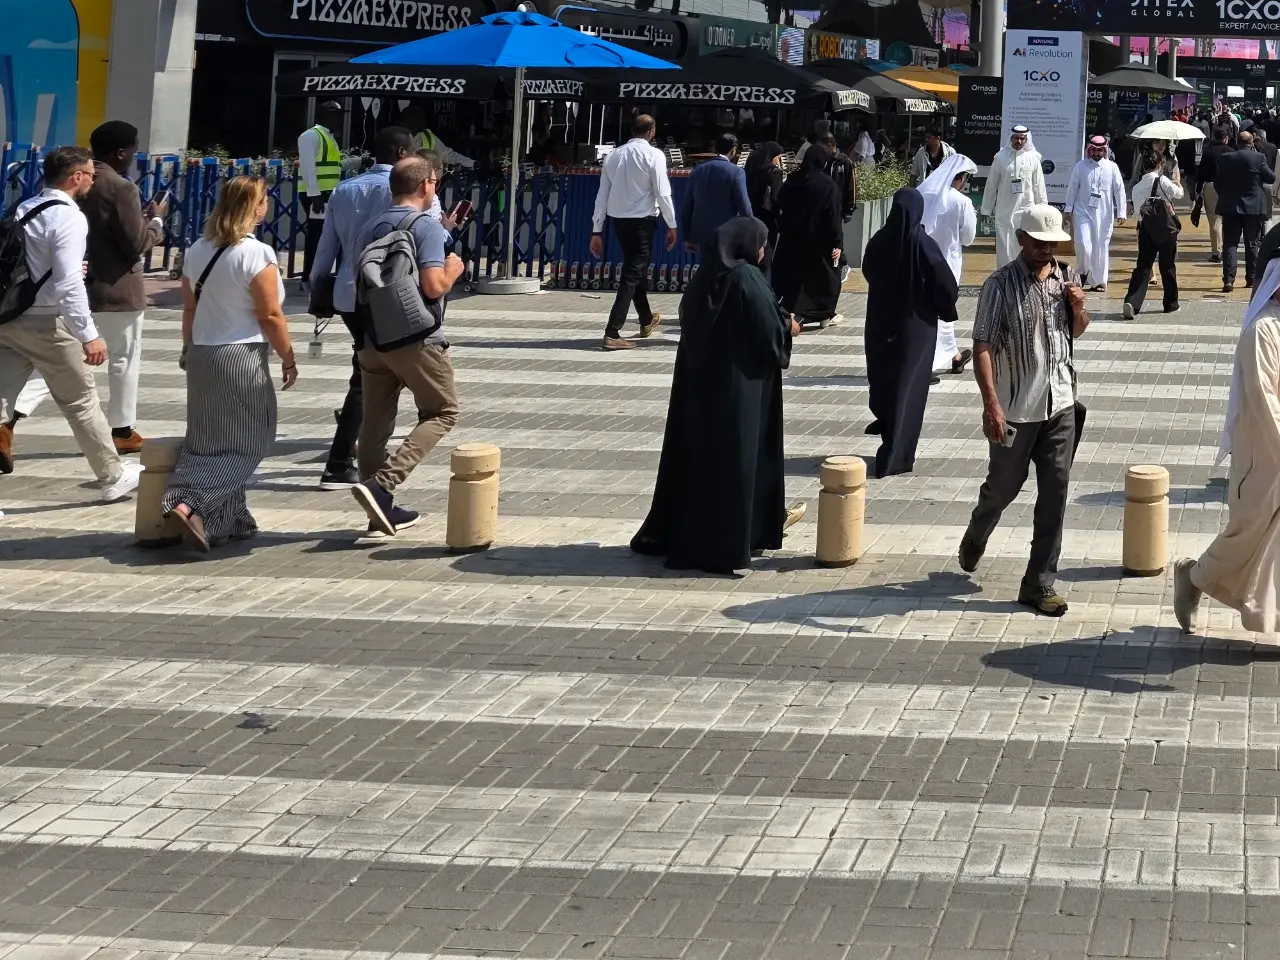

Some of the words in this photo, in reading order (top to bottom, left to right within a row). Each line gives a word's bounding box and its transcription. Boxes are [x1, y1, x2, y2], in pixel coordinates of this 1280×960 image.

[1131, 9, 1195, 18] GLOBAL
[1220, 22, 1249, 30] EXPERT
[1251, 22, 1280, 30] ADVICE
[819, 35, 857, 60] ROBOCHEF
[1029, 48, 1073, 58] Revolution
[1023, 68, 1060, 81] 1CXO
[303, 74, 466, 95] PIZZAEXPRESS
[971, 84, 998, 92] Omada
[619, 82, 797, 105] PIZZAEXPRESS
